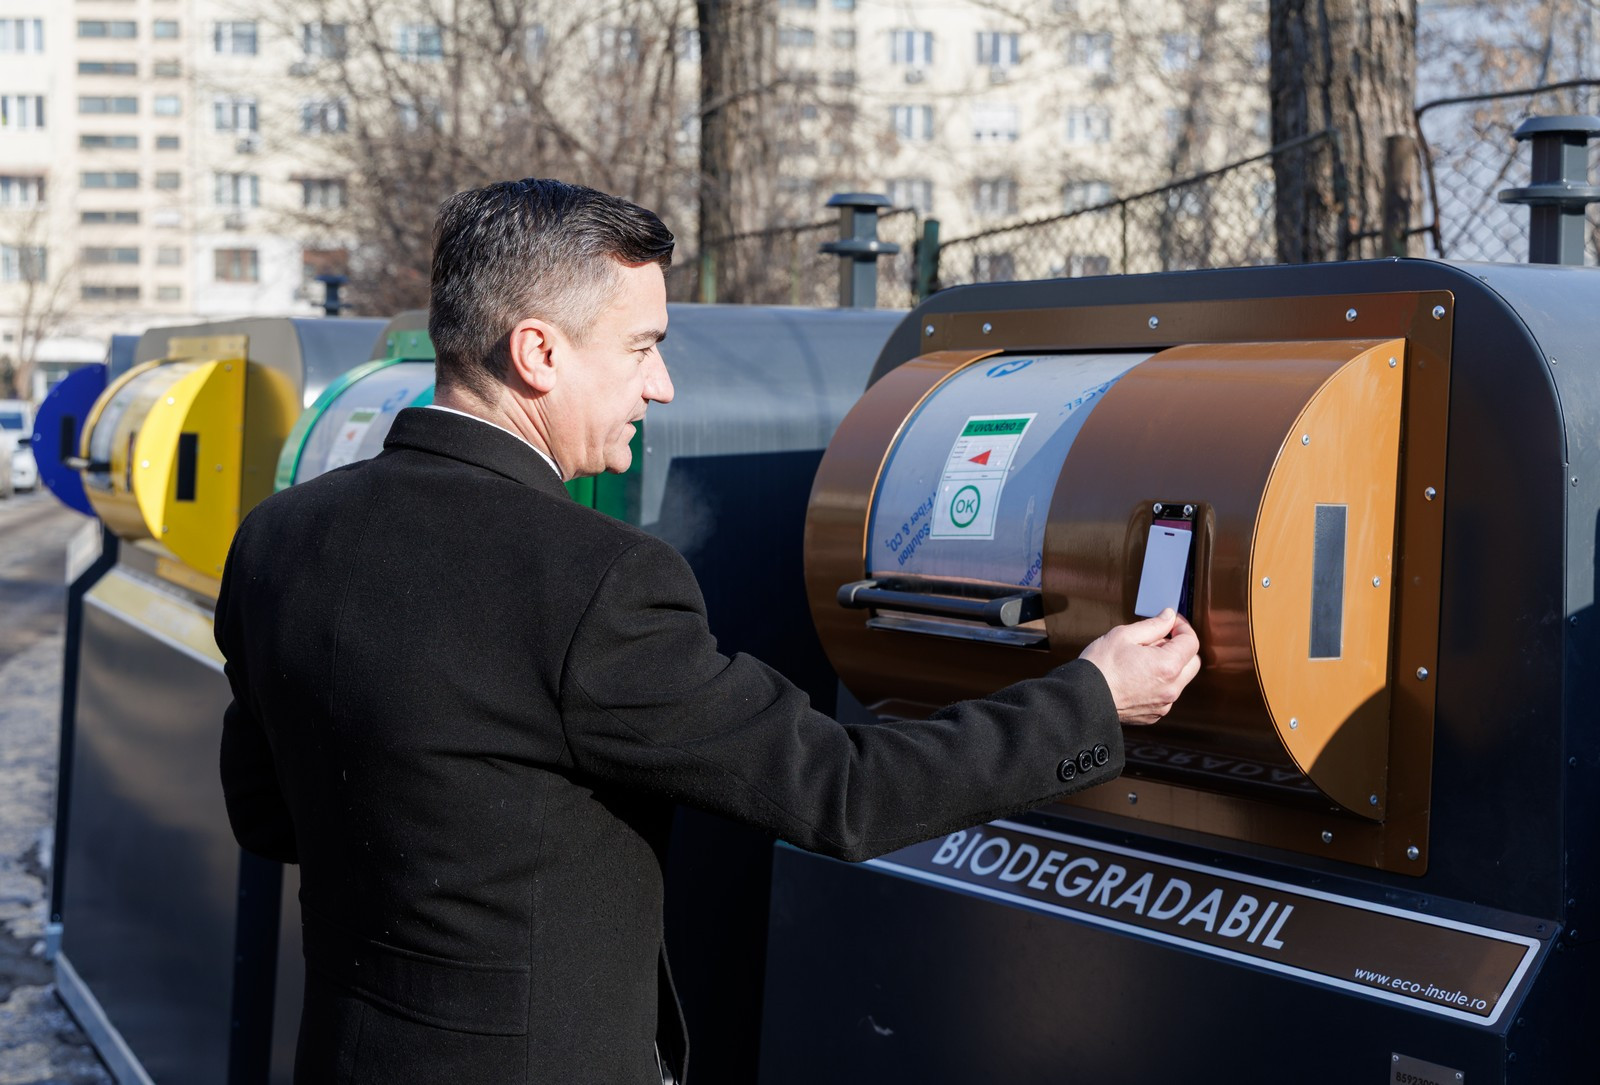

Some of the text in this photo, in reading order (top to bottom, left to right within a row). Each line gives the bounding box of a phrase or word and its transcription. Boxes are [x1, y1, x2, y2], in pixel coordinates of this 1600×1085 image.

[910, 496, 933, 525] Fiber
[955, 499, 976, 514] OK
[897, 523, 930, 566] Solution
[902, 523, 911, 536] &
[931, 829, 1295, 950] BIODEGRADABIL
[1354, 968, 1487, 1010] www.eco-insule.ro
